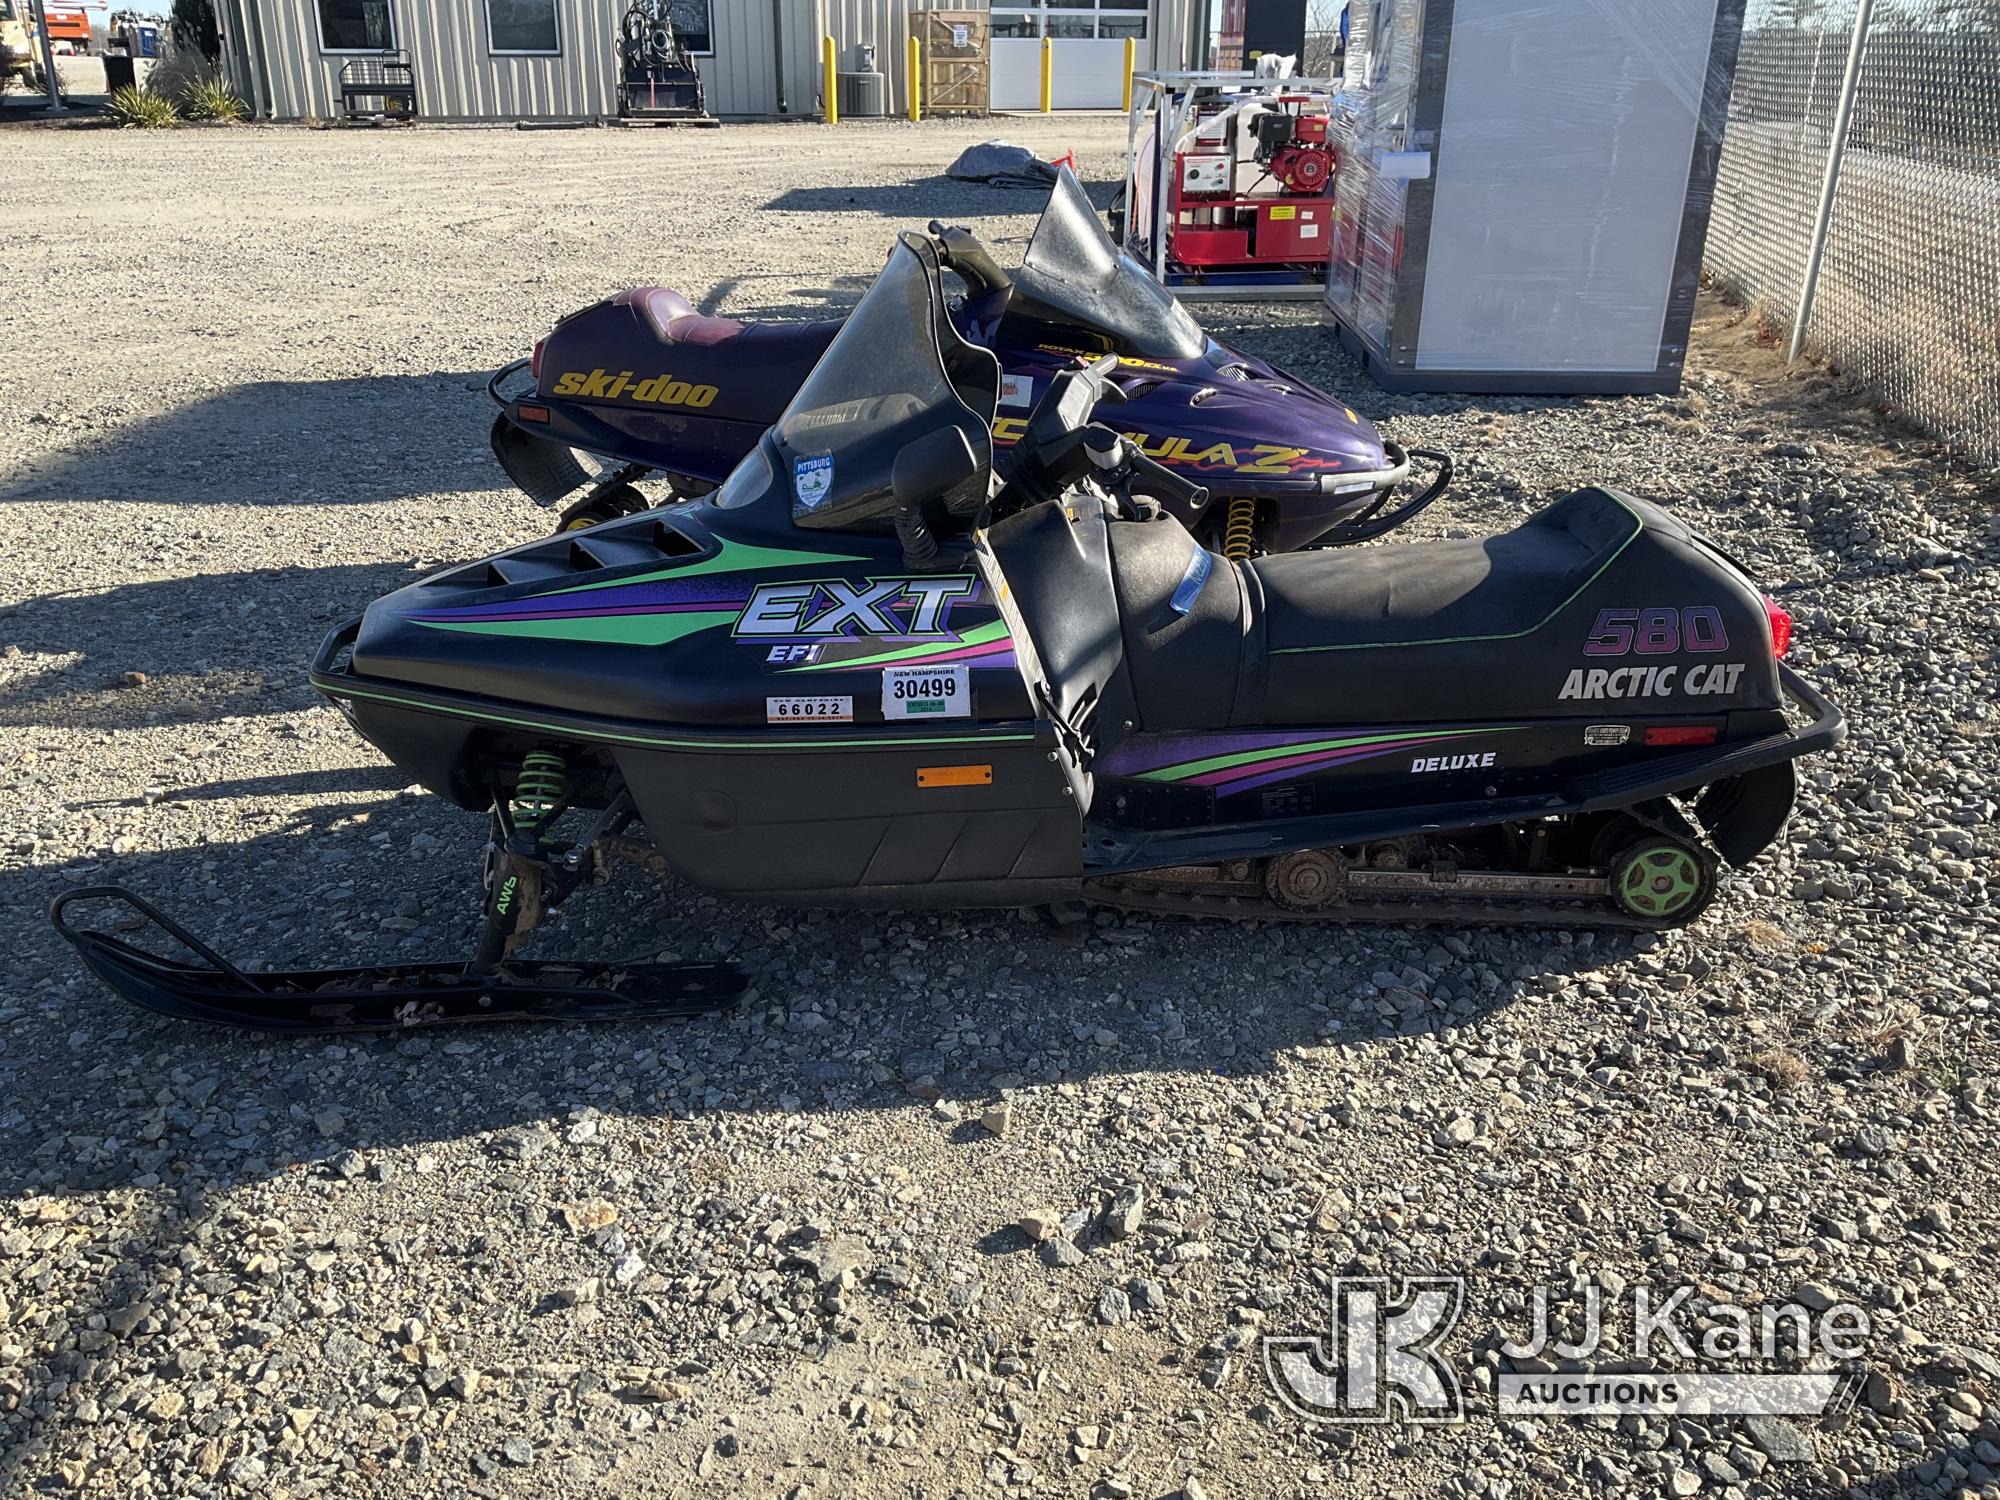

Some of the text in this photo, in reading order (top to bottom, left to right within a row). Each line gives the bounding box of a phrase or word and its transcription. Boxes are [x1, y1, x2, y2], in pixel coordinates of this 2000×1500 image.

[552, 368, 720, 408] ski-doo
[797, 457, 831, 473] PITTSBURG
[1234, 444, 1310, 474] Z
[731, 574, 977, 638] EXT
[1583, 605, 1729, 657] 580
[766, 645, 820, 662] EFI
[912, 669, 956, 677] HAMPSHIRE
[1557, 663, 1746, 700] ARCTIC CAT
[893, 677, 956, 699] 30499
[778, 703, 840, 715] 66022
[1411, 752, 1497, 773] DELUXE
